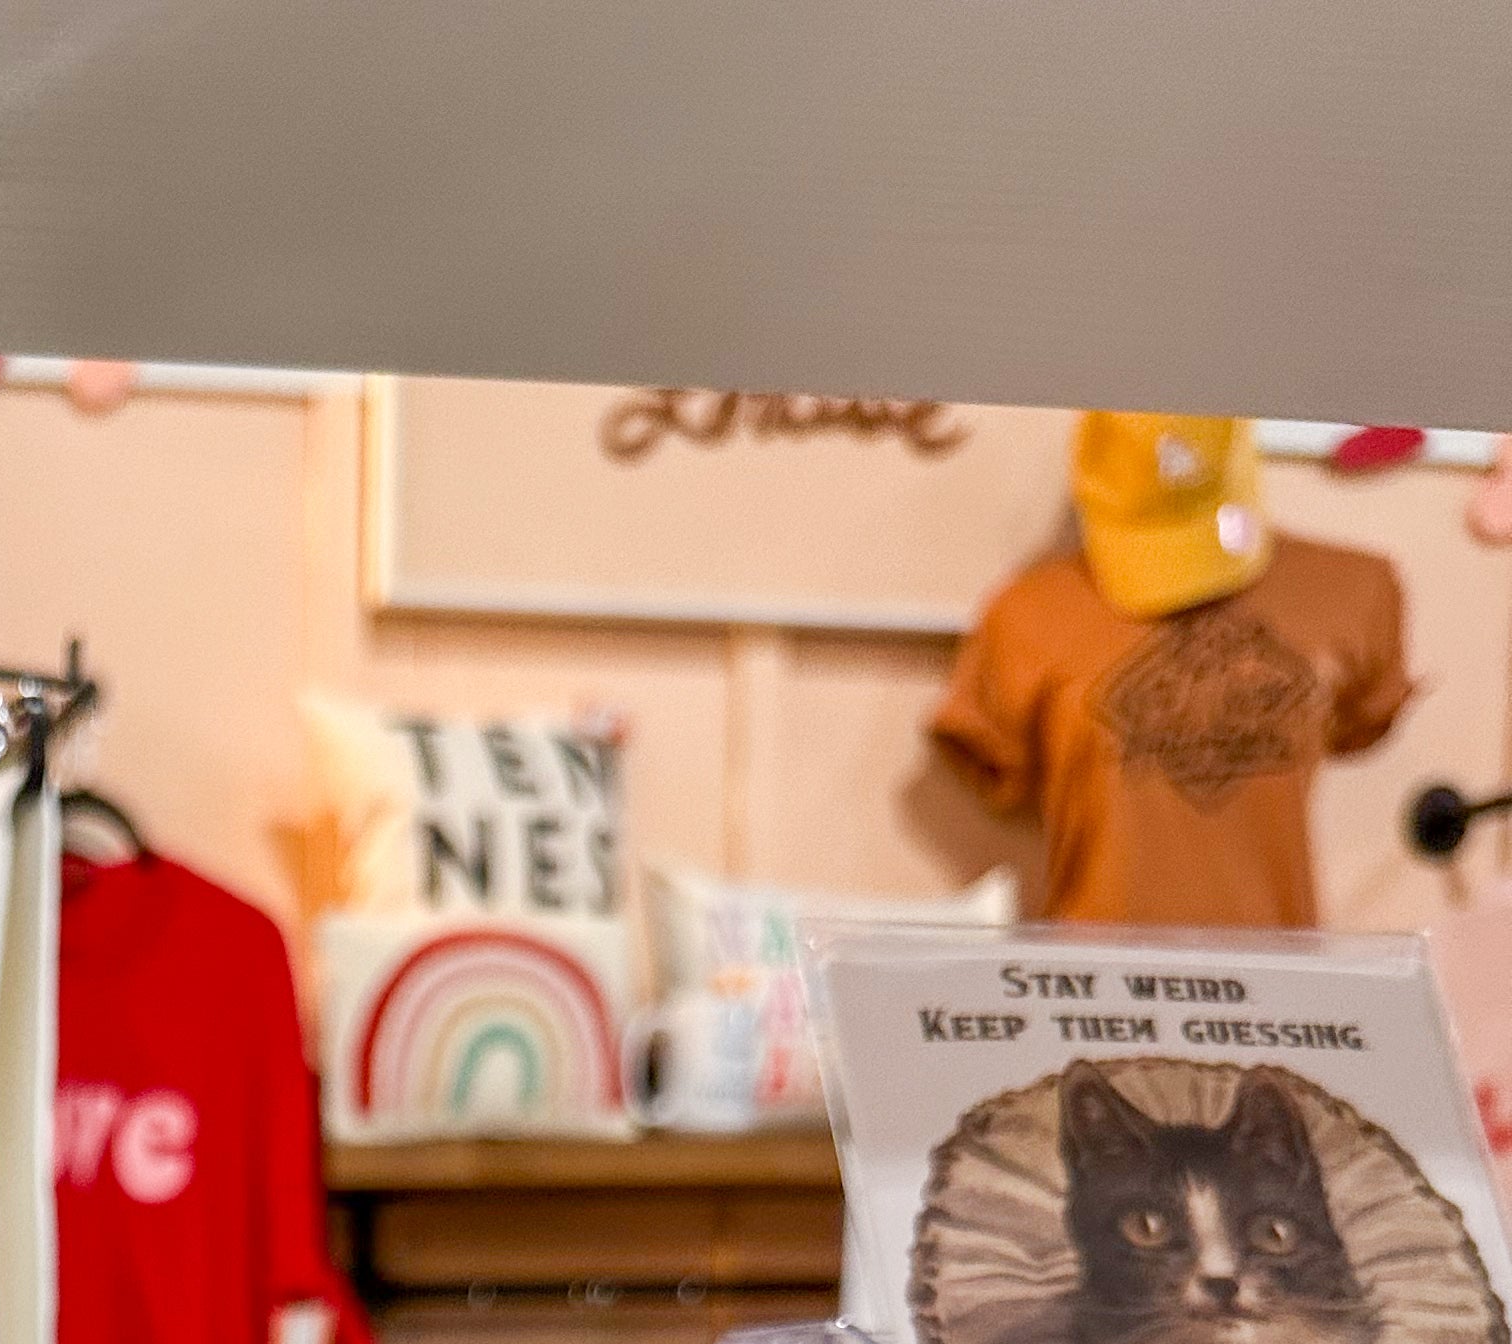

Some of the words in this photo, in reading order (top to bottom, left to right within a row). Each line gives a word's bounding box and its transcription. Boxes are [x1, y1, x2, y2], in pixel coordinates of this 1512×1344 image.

[999, 964, 1096, 1001] STAY
[1125, 974, 1247, 1005] WEIRD
[918, 1006, 1027, 1042] KEEP
